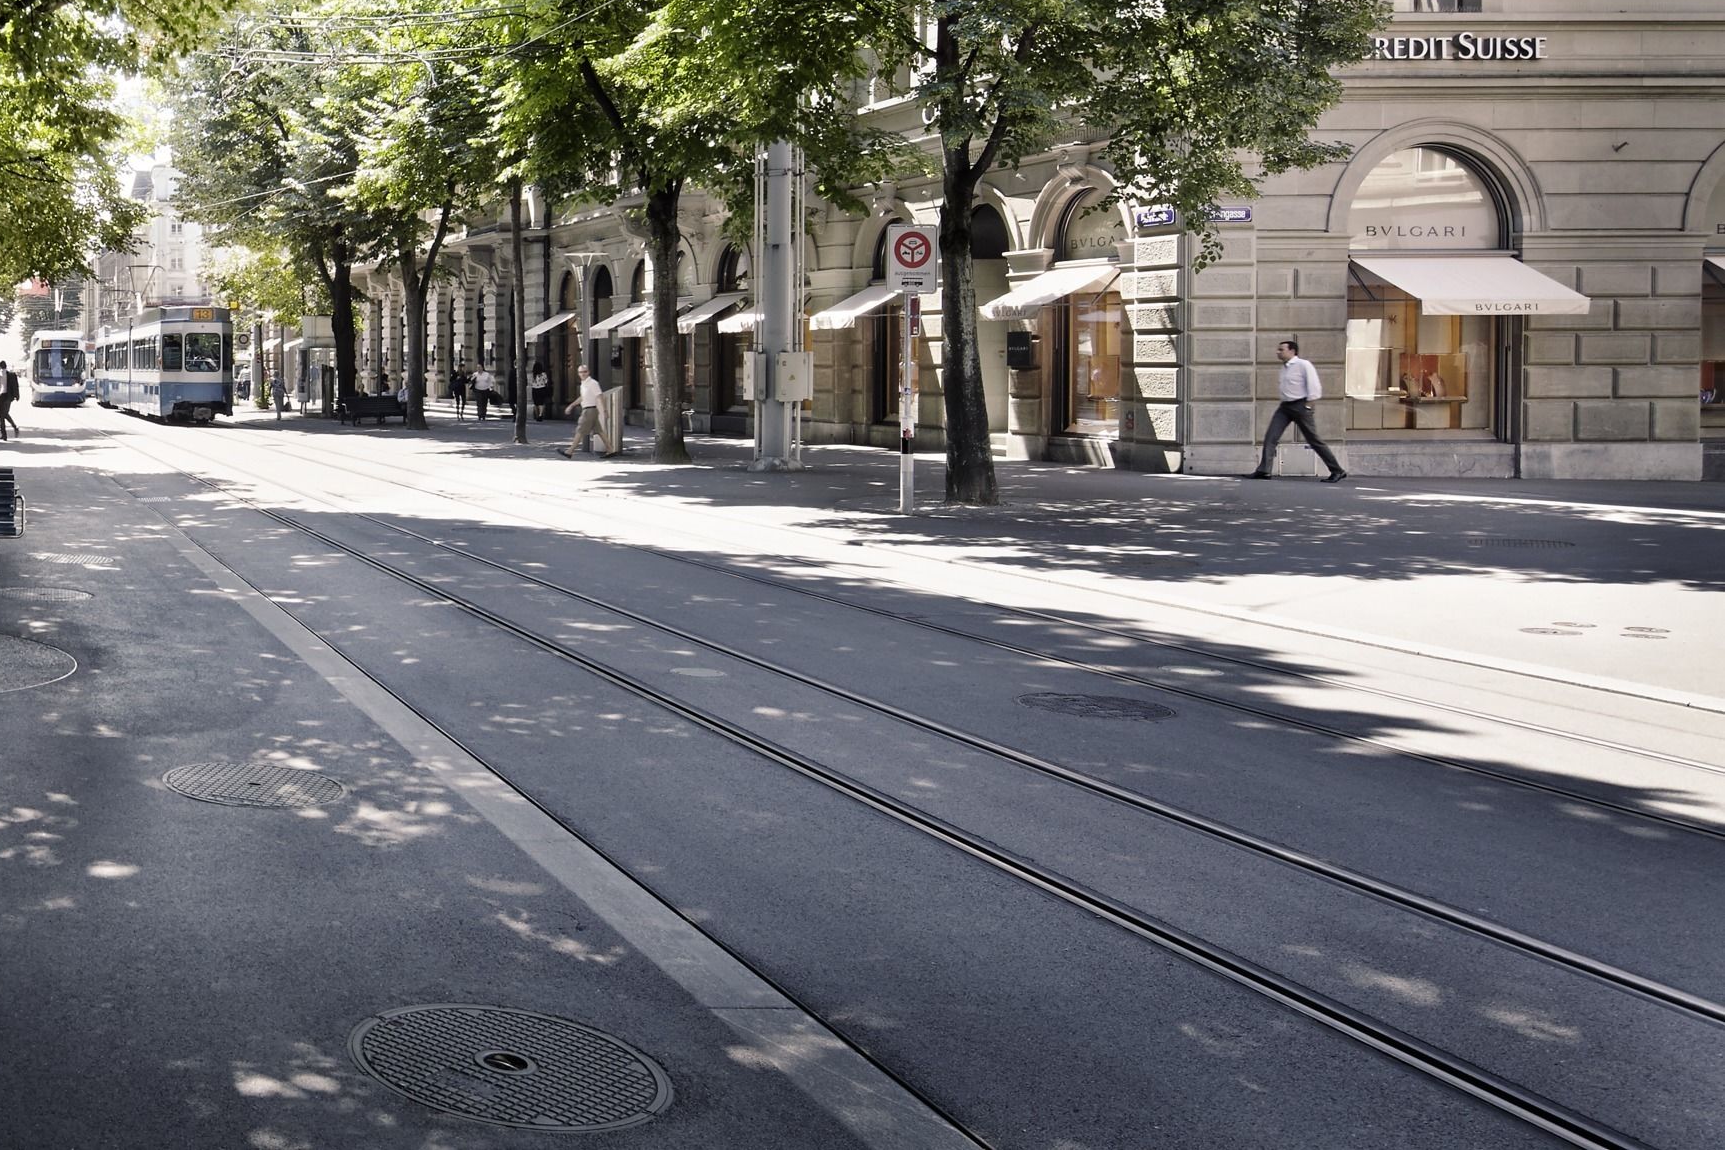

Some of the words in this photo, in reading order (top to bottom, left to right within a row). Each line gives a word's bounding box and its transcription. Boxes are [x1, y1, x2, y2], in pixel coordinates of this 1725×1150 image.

[1458, 31, 1548, 60] SUISSE
[1366, 225, 1466, 237] BVLGARI
[1475, 303, 1539, 312] BVLGARI
[194, 310, 210, 319] 13
